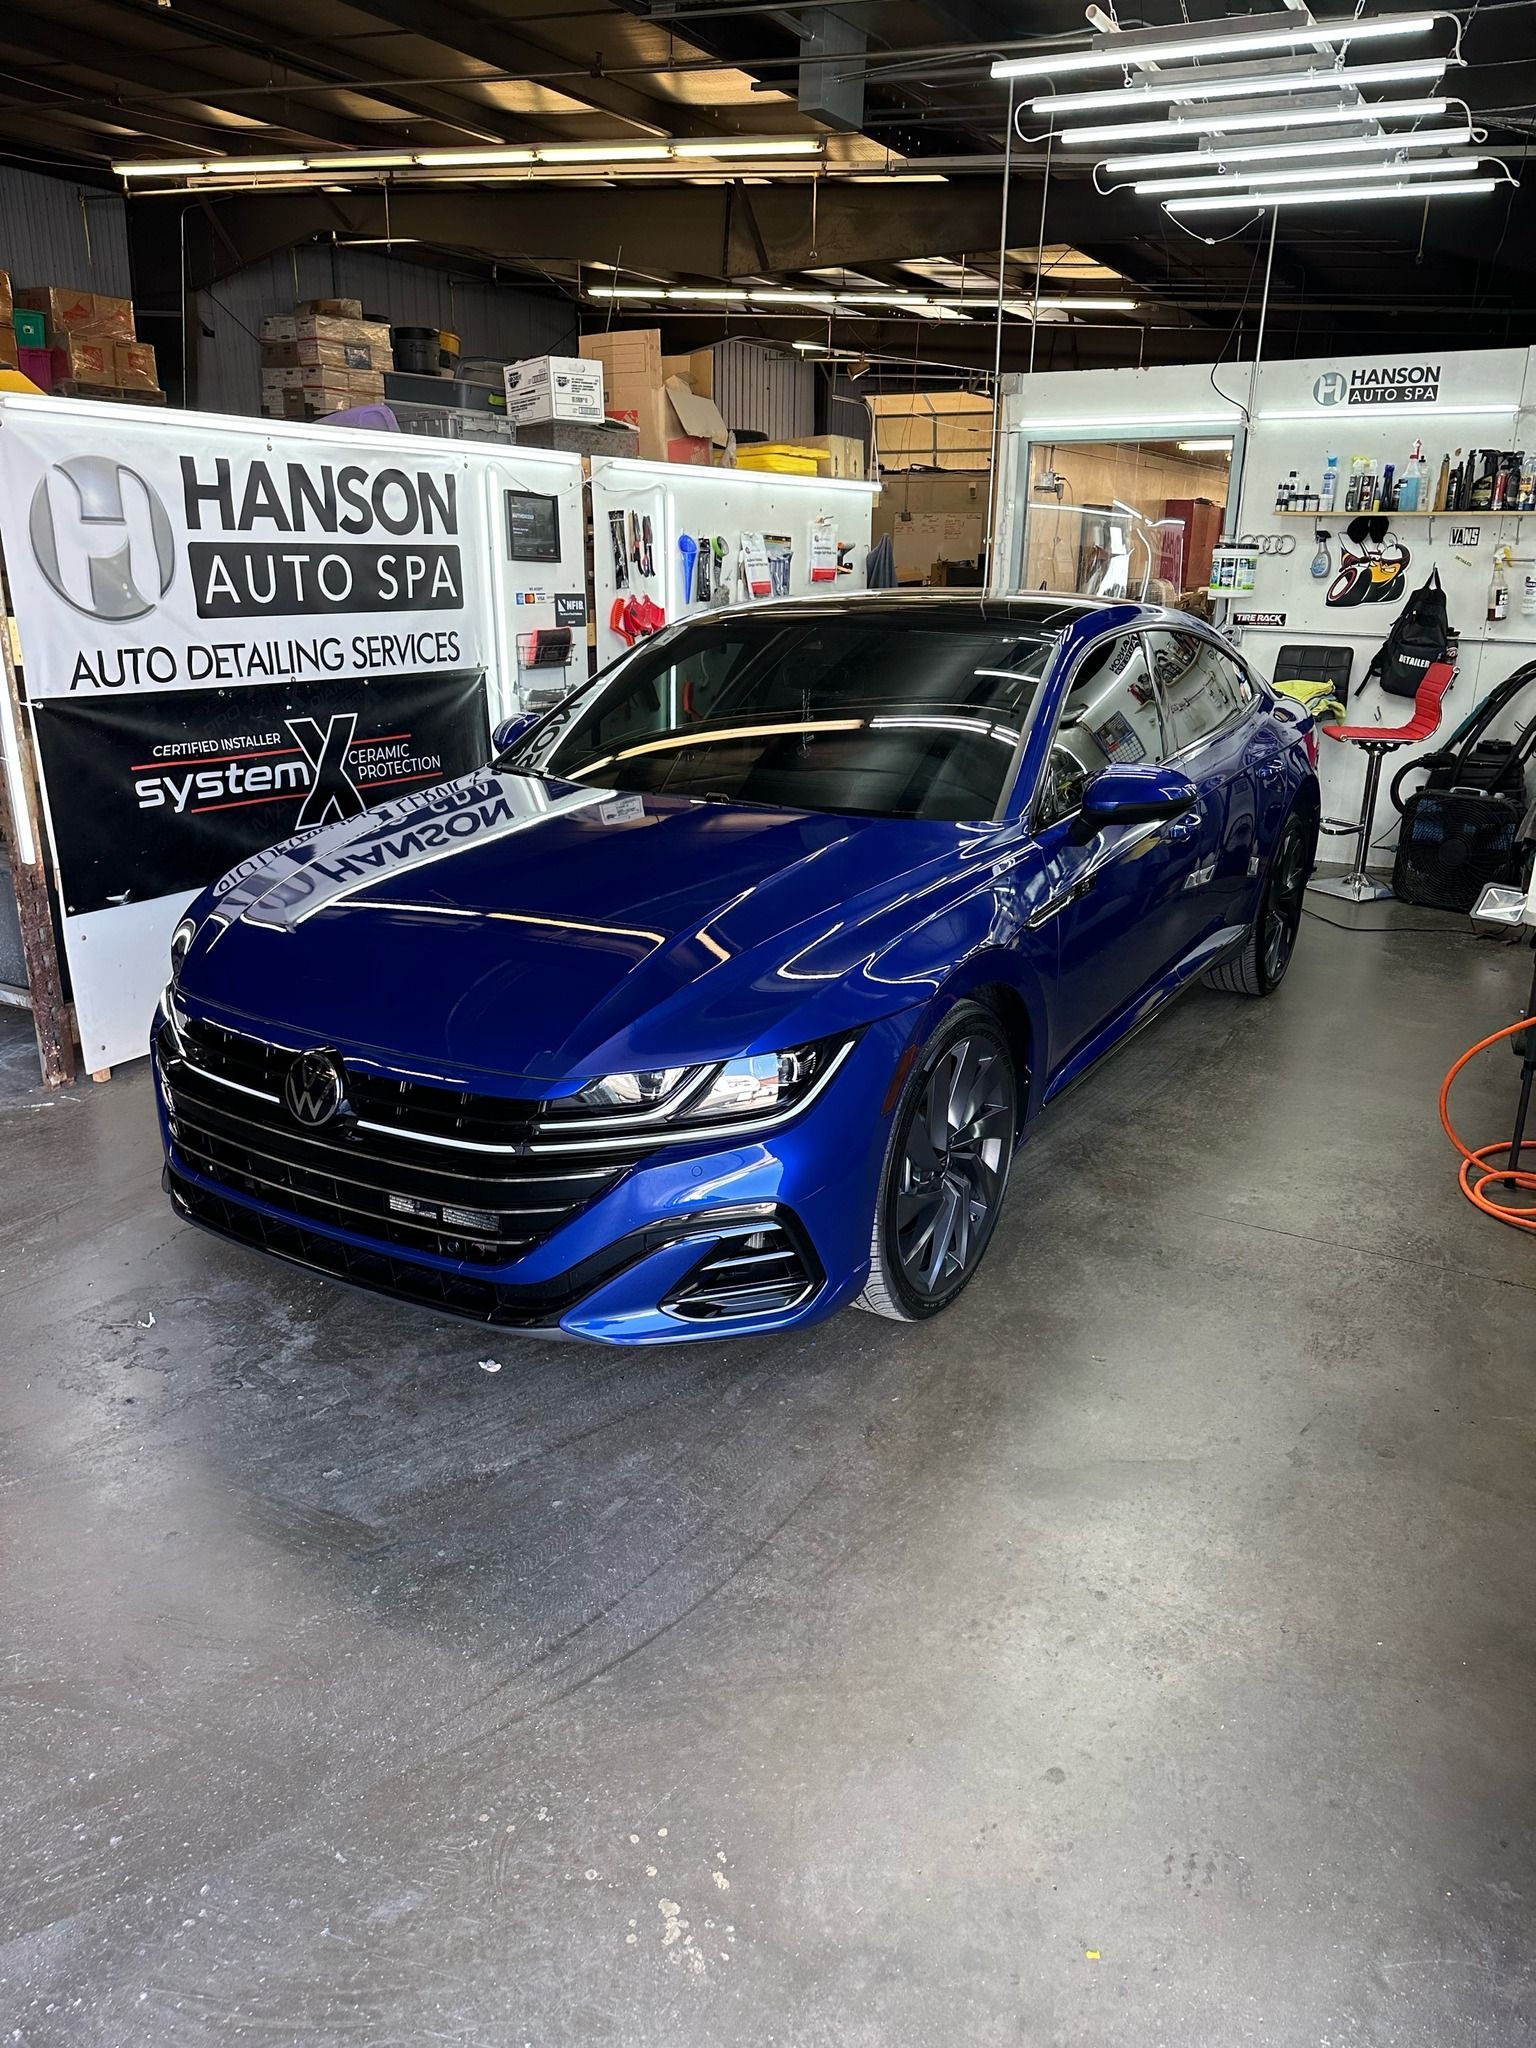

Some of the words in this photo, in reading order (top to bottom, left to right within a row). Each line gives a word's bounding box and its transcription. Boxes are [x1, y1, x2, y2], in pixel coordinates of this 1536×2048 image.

[1351, 366, 1441, 386] HANSON
[1351, 389, 1397, 402] AUTO
[1404, 387, 1435, 400] SPA
[179, 455, 458, 535] HANSON
[1451, 528, 1479, 545] VANS
[205, 554, 353, 604] AUTO
[377, 554, 458, 601] SPA
[1237, 614, 1257, 622] TIRE
[1257, 614, 1283, 625] RACK
[69, 646, 177, 690] AUTO
[187, 637, 344, 680] DETAILING
[352, 631, 461, 669] SERVICES
[1398, 654, 1430, 669] DETAILER
[152, 741, 219, 757] CERTIFIED
[221, 732, 281, 751] INSTALLER
[348, 743, 410, 765] CERAMIC
[358, 755, 441, 781] PROTECTION
